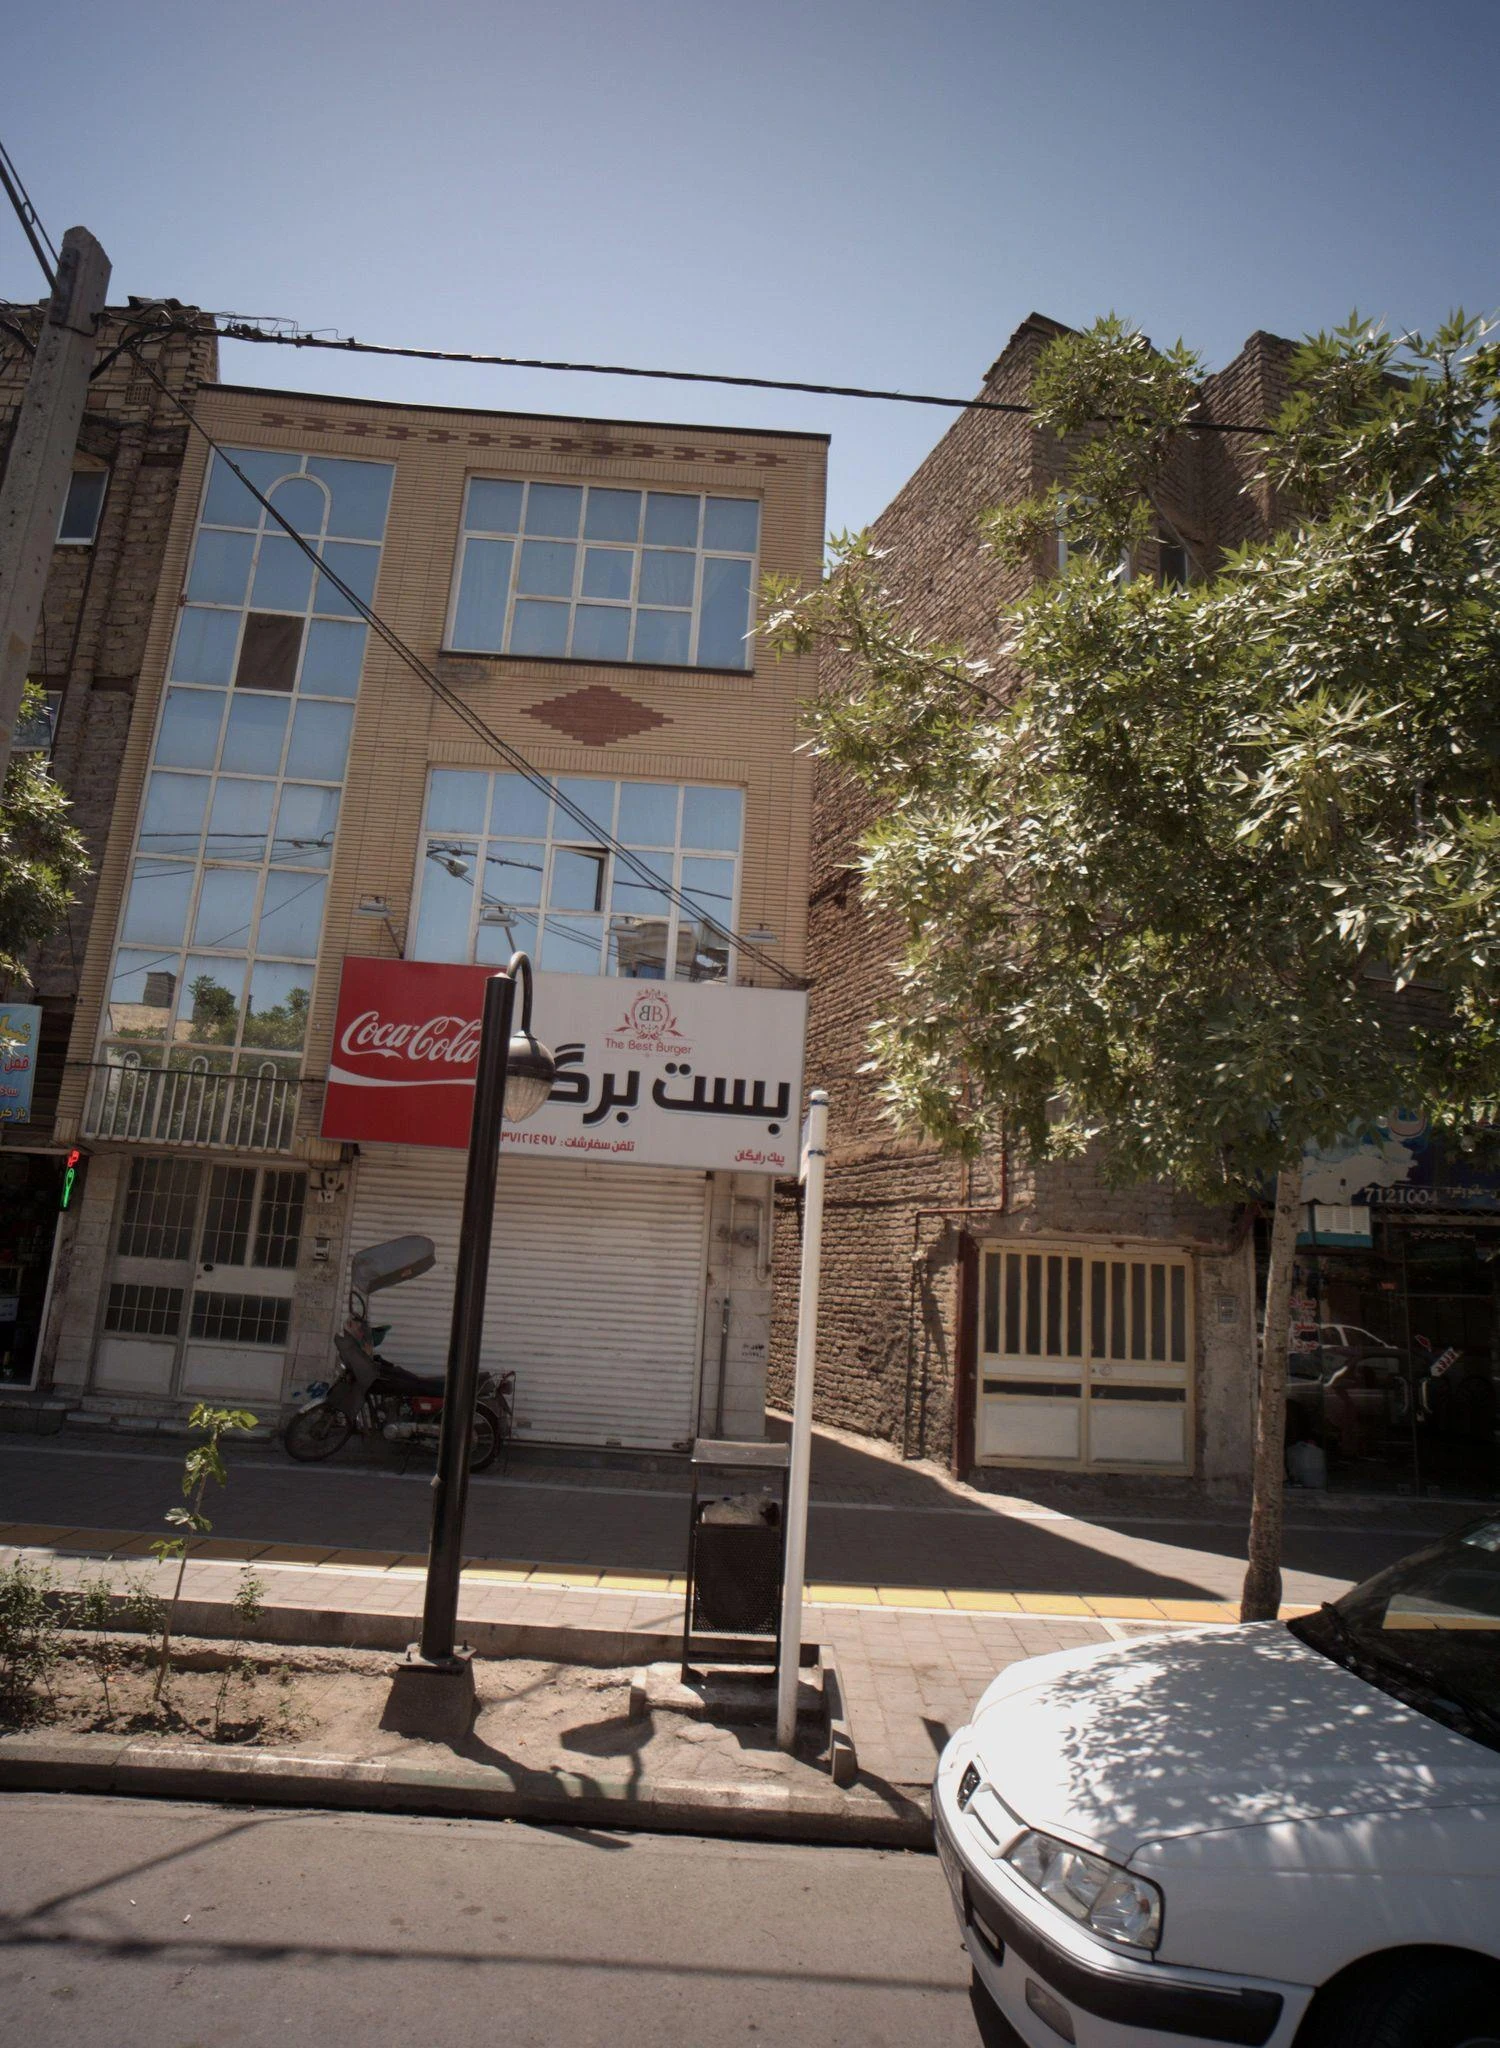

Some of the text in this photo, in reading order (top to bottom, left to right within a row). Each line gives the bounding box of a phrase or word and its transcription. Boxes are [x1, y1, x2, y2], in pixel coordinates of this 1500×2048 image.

[340, 1011, 481, 1063] Coca-Cola
[605, 1038, 693, 1056] The Best Burger
[652, 1062, 790, 1135] بست
[611, 1141, 636, 1153] تلفن
